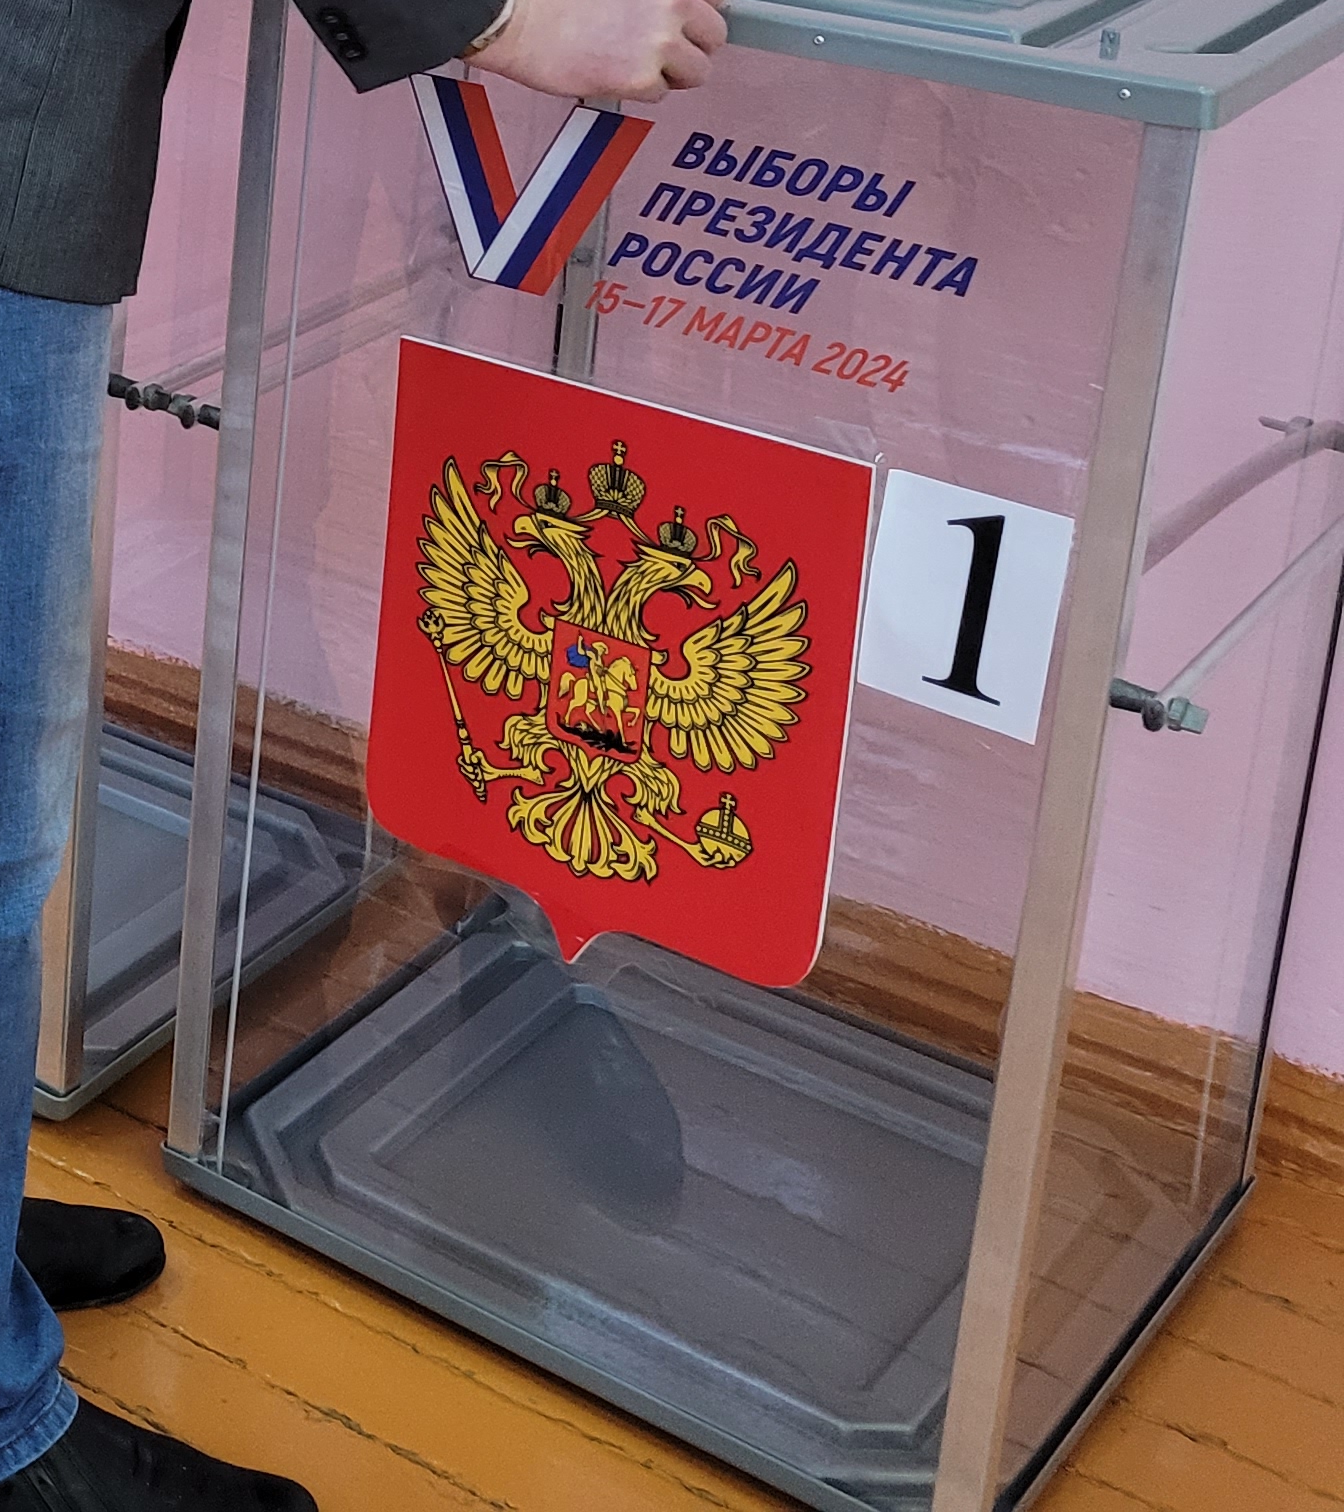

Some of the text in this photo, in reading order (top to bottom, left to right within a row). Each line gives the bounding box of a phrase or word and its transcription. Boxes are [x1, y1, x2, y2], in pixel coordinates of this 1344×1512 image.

[671, 131, 917, 219] ВЫБОРЫ
[606, 231, 822, 316] РОССИИ
[638, 181, 980, 299] ПРЕЗИДЕНТА
[682, 305, 812, 368] МАРТА
[811, 342, 911, 394] 2024
[921, 514, 1007, 707] 1
